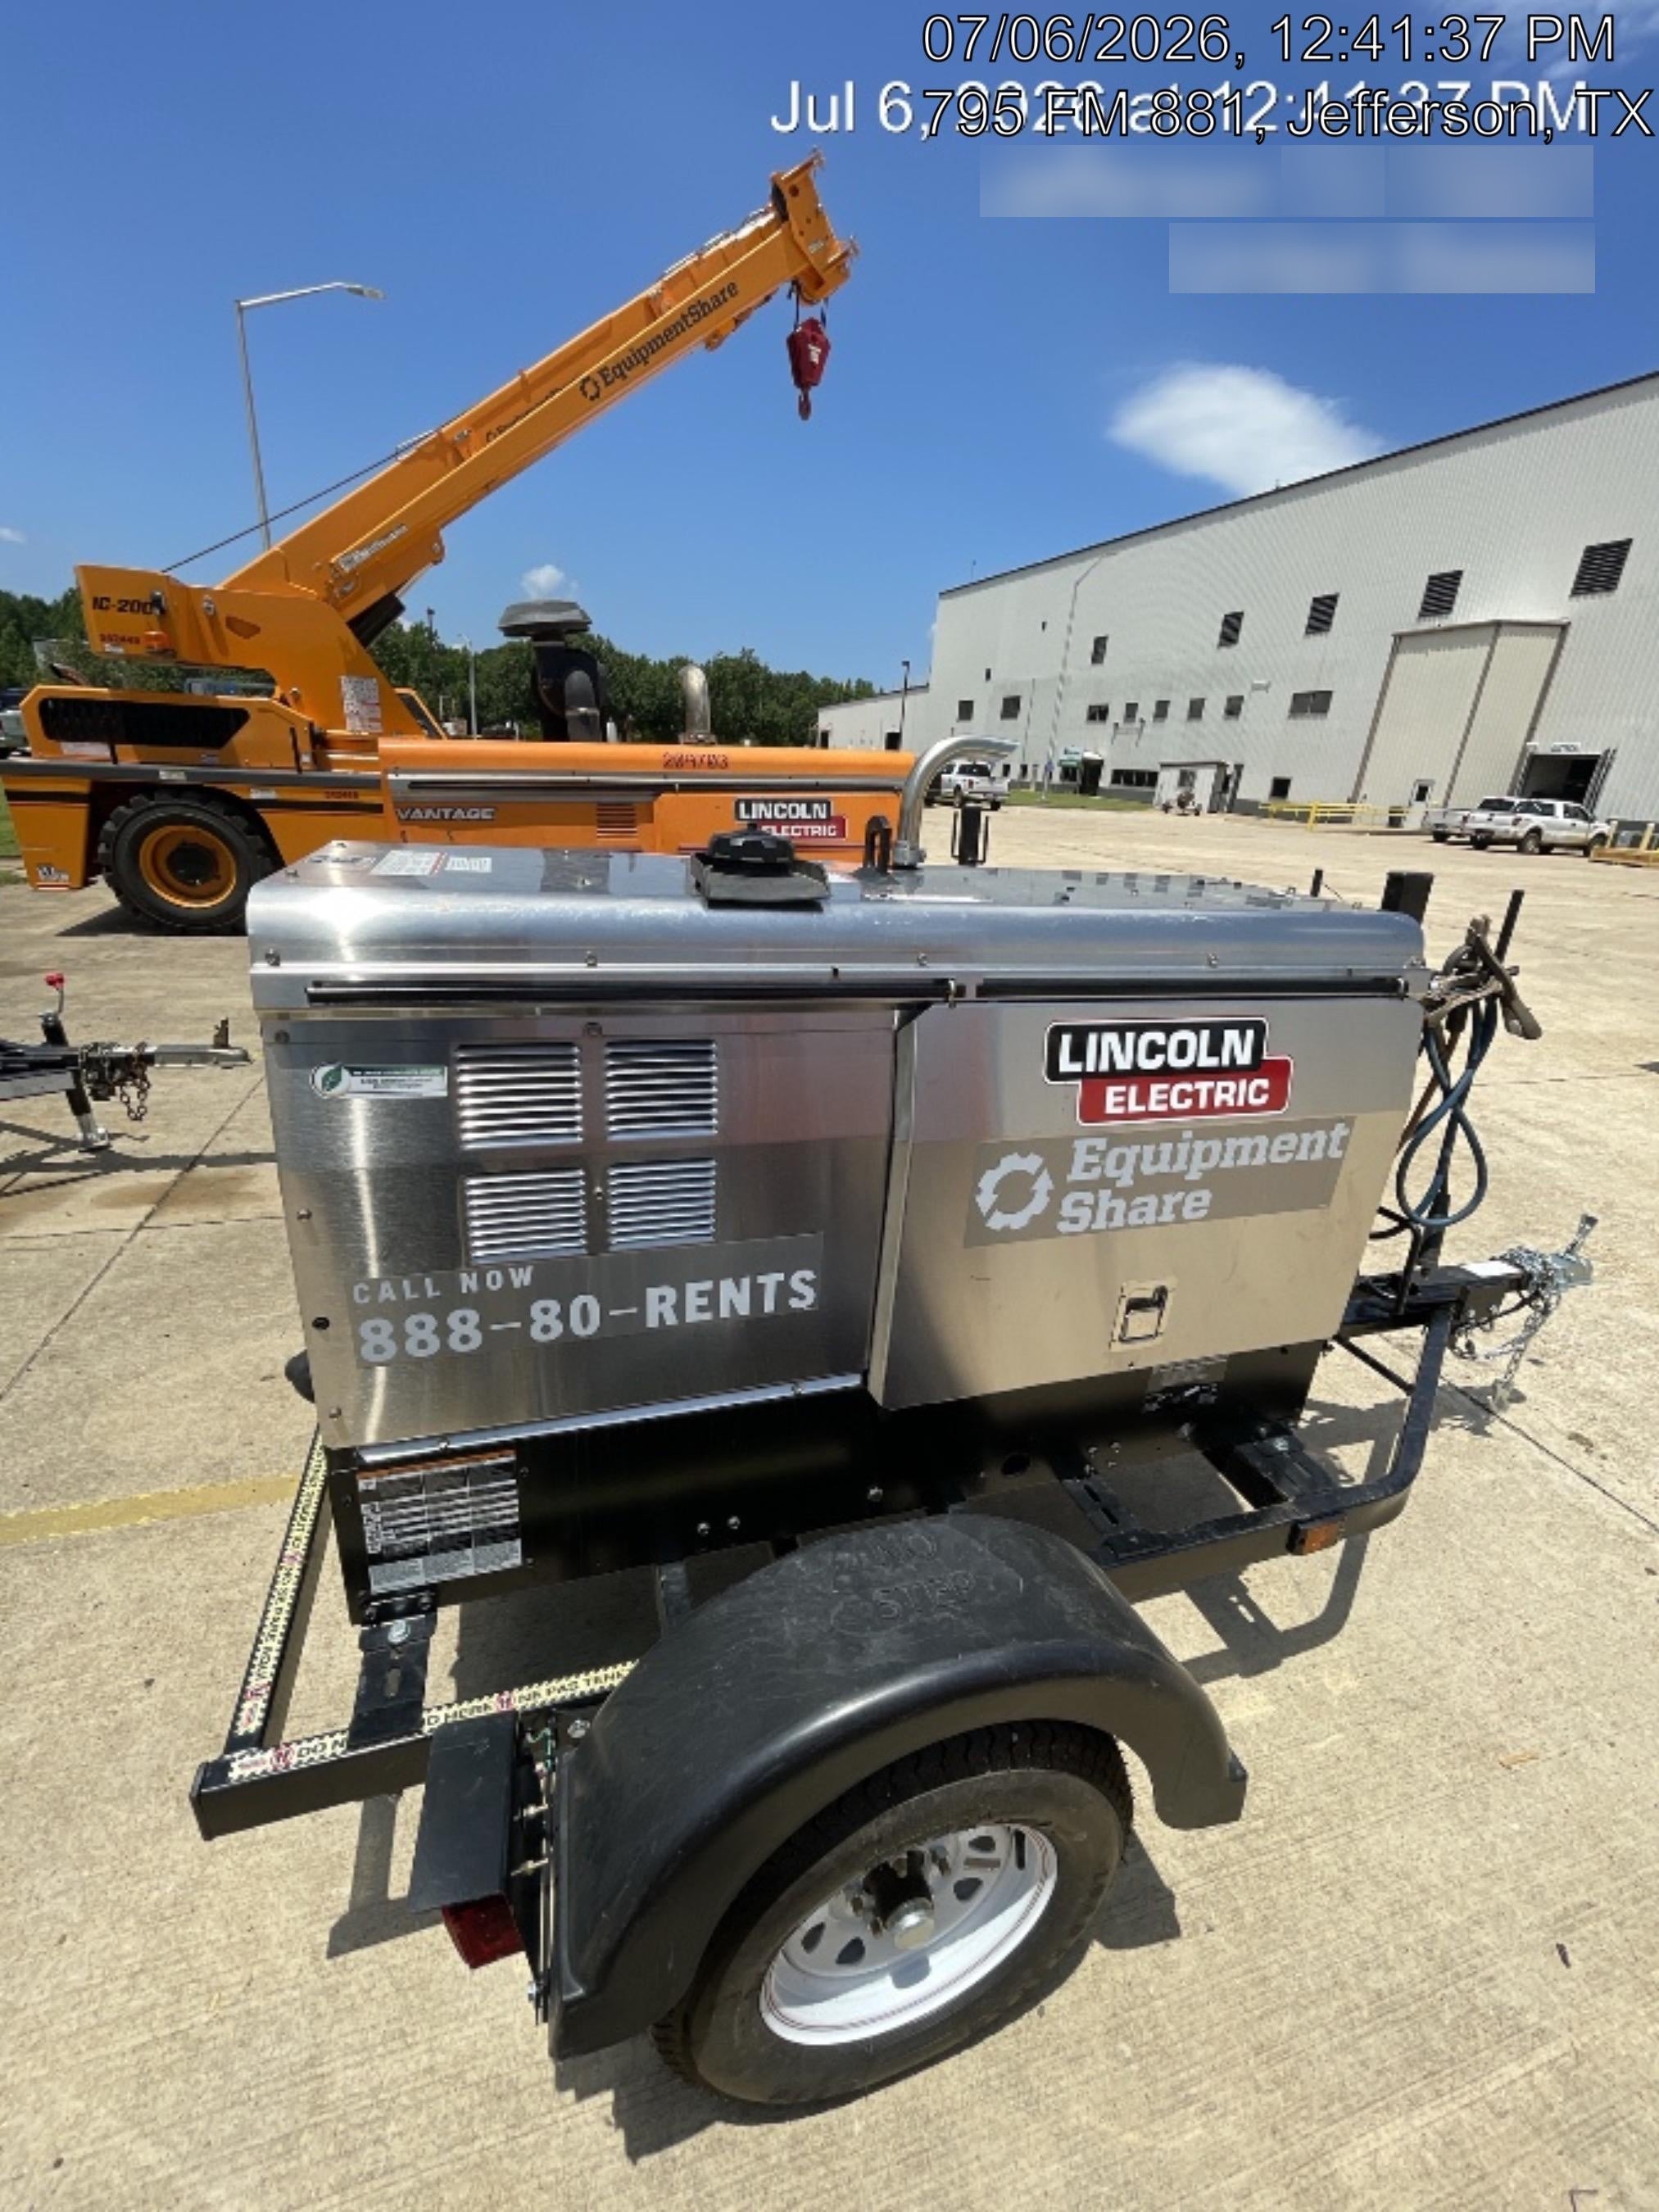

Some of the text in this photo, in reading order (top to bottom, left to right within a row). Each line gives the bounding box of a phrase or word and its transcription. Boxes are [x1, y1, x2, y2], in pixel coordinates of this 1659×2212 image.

[597, 282, 739, 387] EquipmentShare
[397, 807, 496, 820] VANTAGE
[739, 801, 827, 820] LINCOLN
[1058, 1029, 1254, 1073] LINCOLN
[1104, 1078, 1270, 1115] ELECTRIC
[1067, 1122, 1351, 1188] Equipment
[1057, 1188, 1213, 1235] Share
[353, 1265, 534, 1304] CALL NOW
[359, 1269, 818, 1362] 888-80-RENTS
